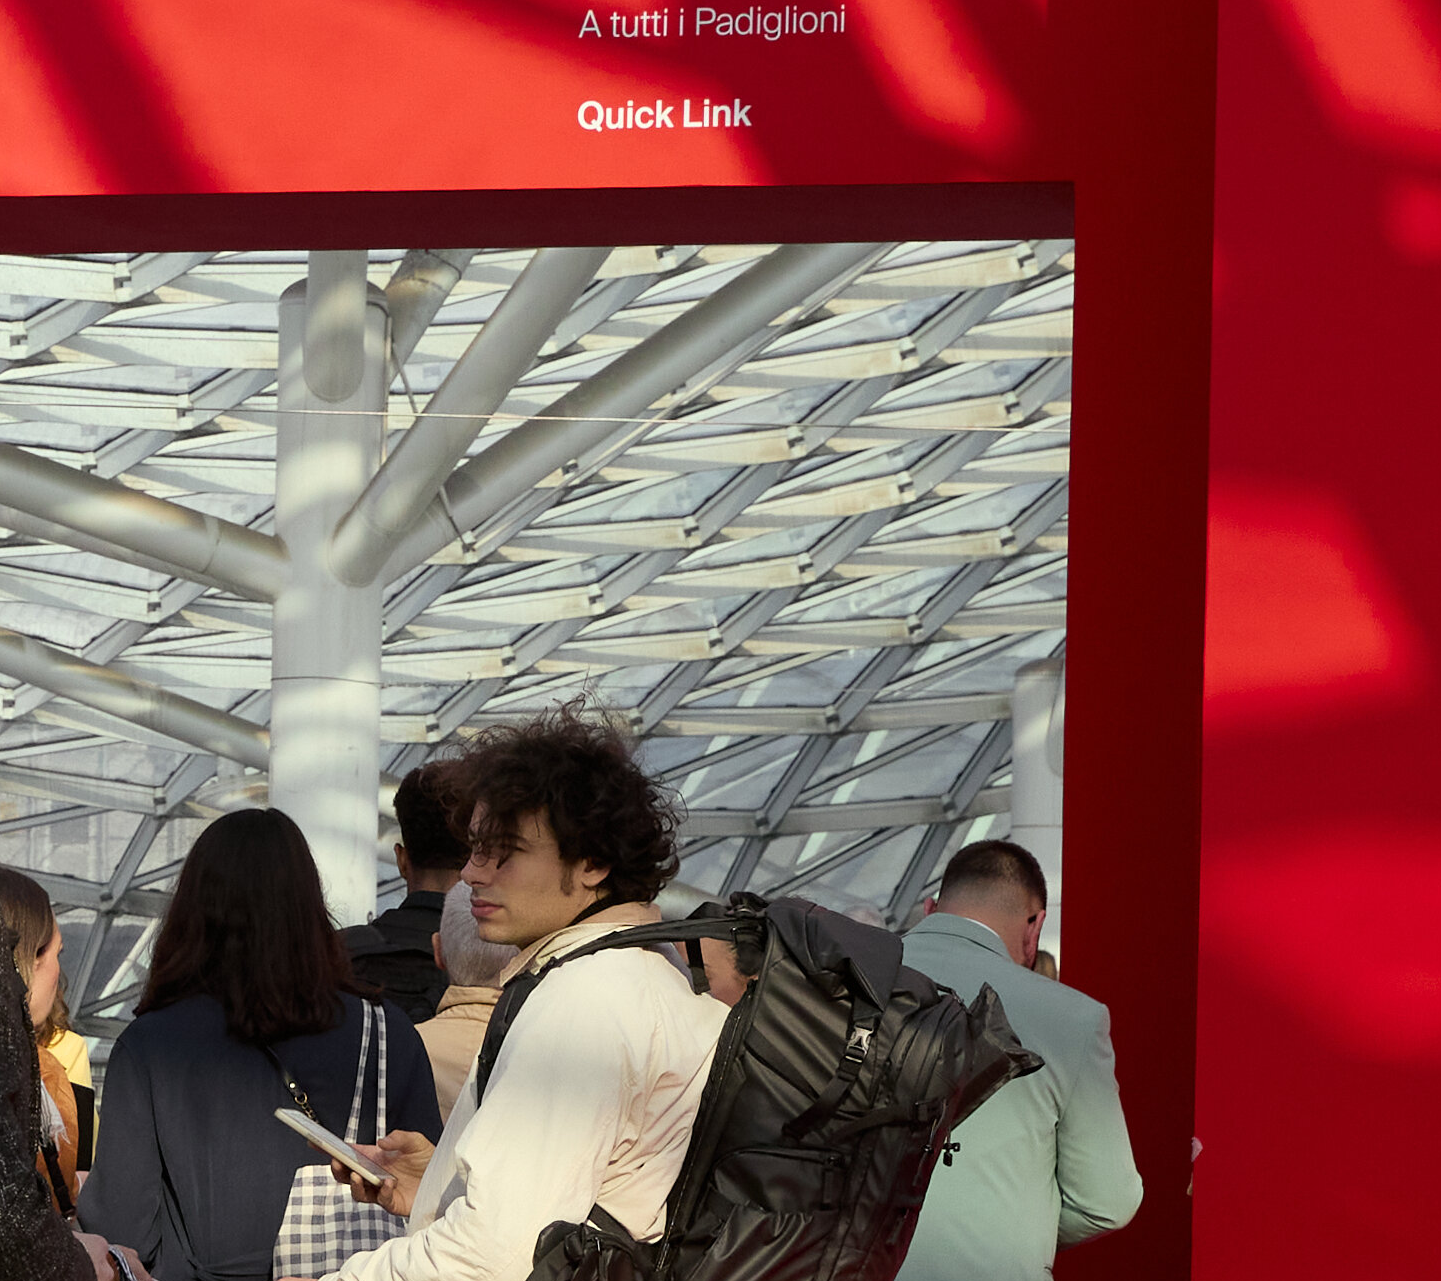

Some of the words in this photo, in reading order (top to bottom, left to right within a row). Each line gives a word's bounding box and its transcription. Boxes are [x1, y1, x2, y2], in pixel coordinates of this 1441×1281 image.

[578, 9, 603, 39] A
[609, 8, 669, 39] tutti
[678, 7, 686, 37] i
[695, 4, 846, 42] Padiglioni
[577, 100, 675, 133] Quick
[682, 98, 752, 129] Link
